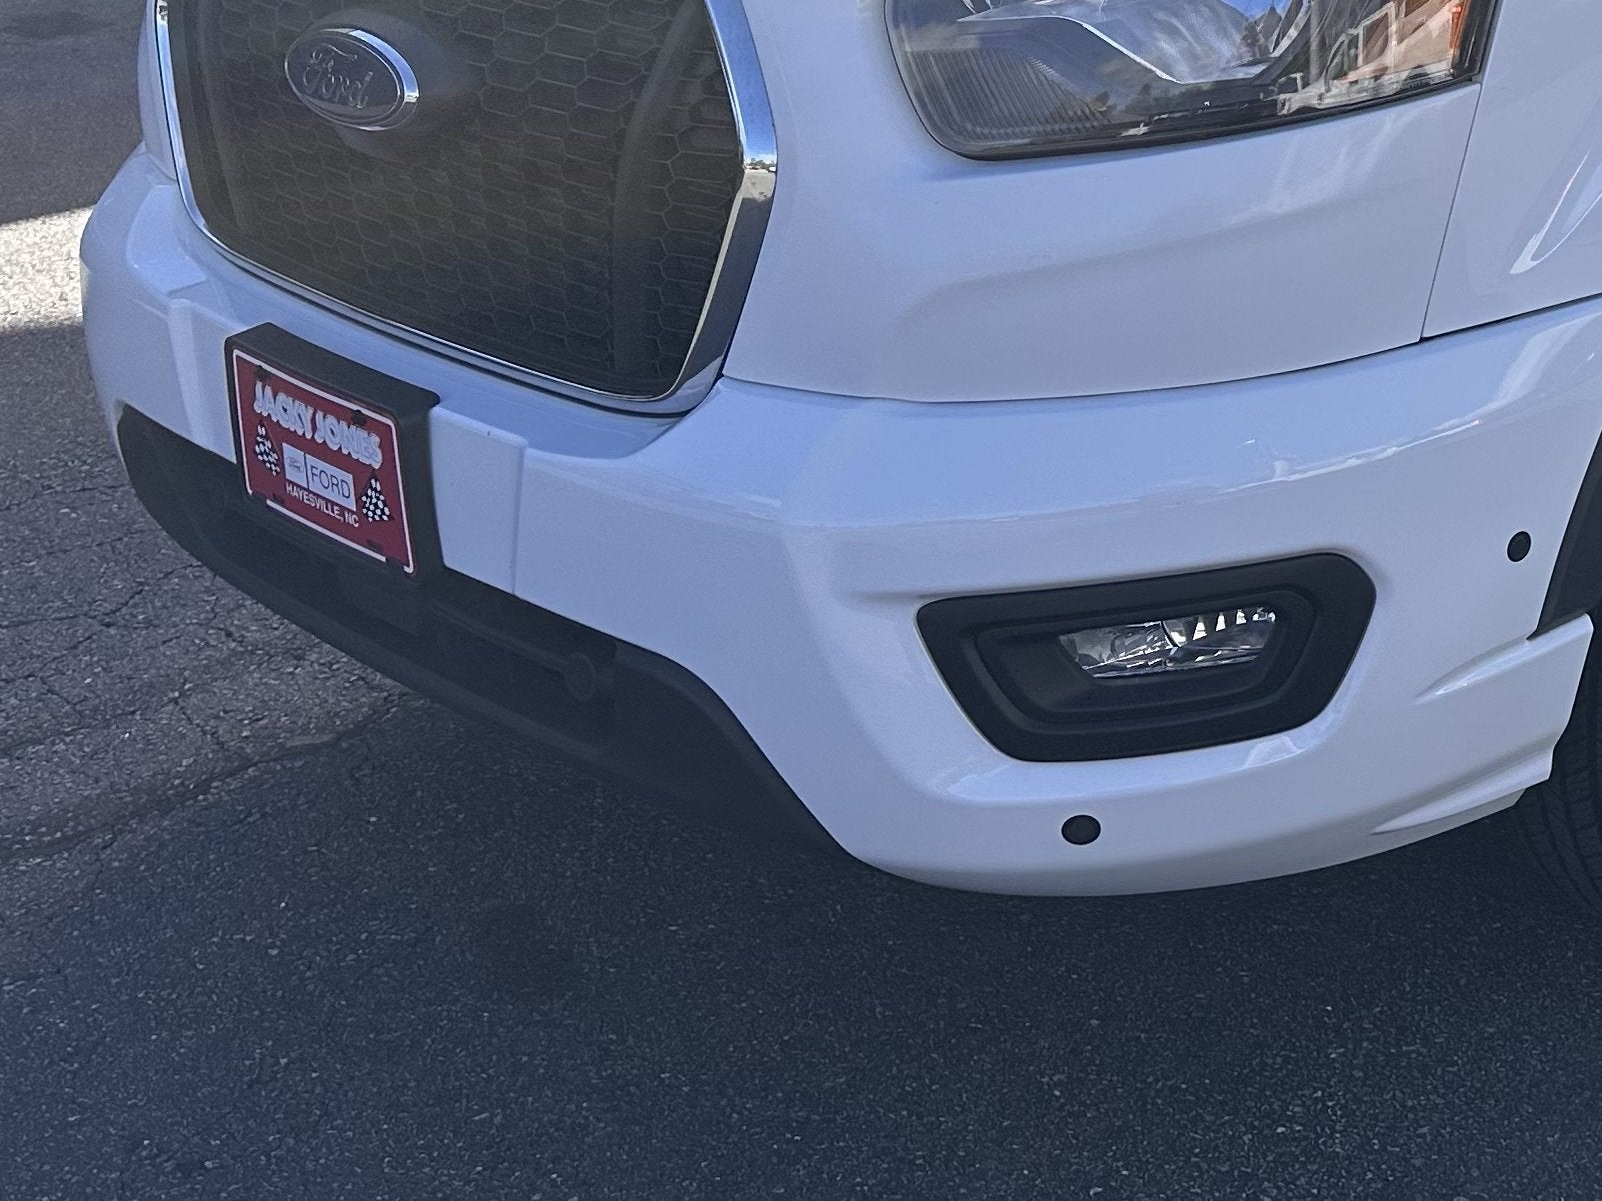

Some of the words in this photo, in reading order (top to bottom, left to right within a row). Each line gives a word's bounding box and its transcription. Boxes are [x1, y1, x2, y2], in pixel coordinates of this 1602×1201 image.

[253, 380, 315, 440] JACKY
[314, 409, 383, 470] JONES
[285, 481, 344, 523] HAYESVILLE,
[344, 510, 360, 528] NC
[310, 464, 351, 499] FORD
